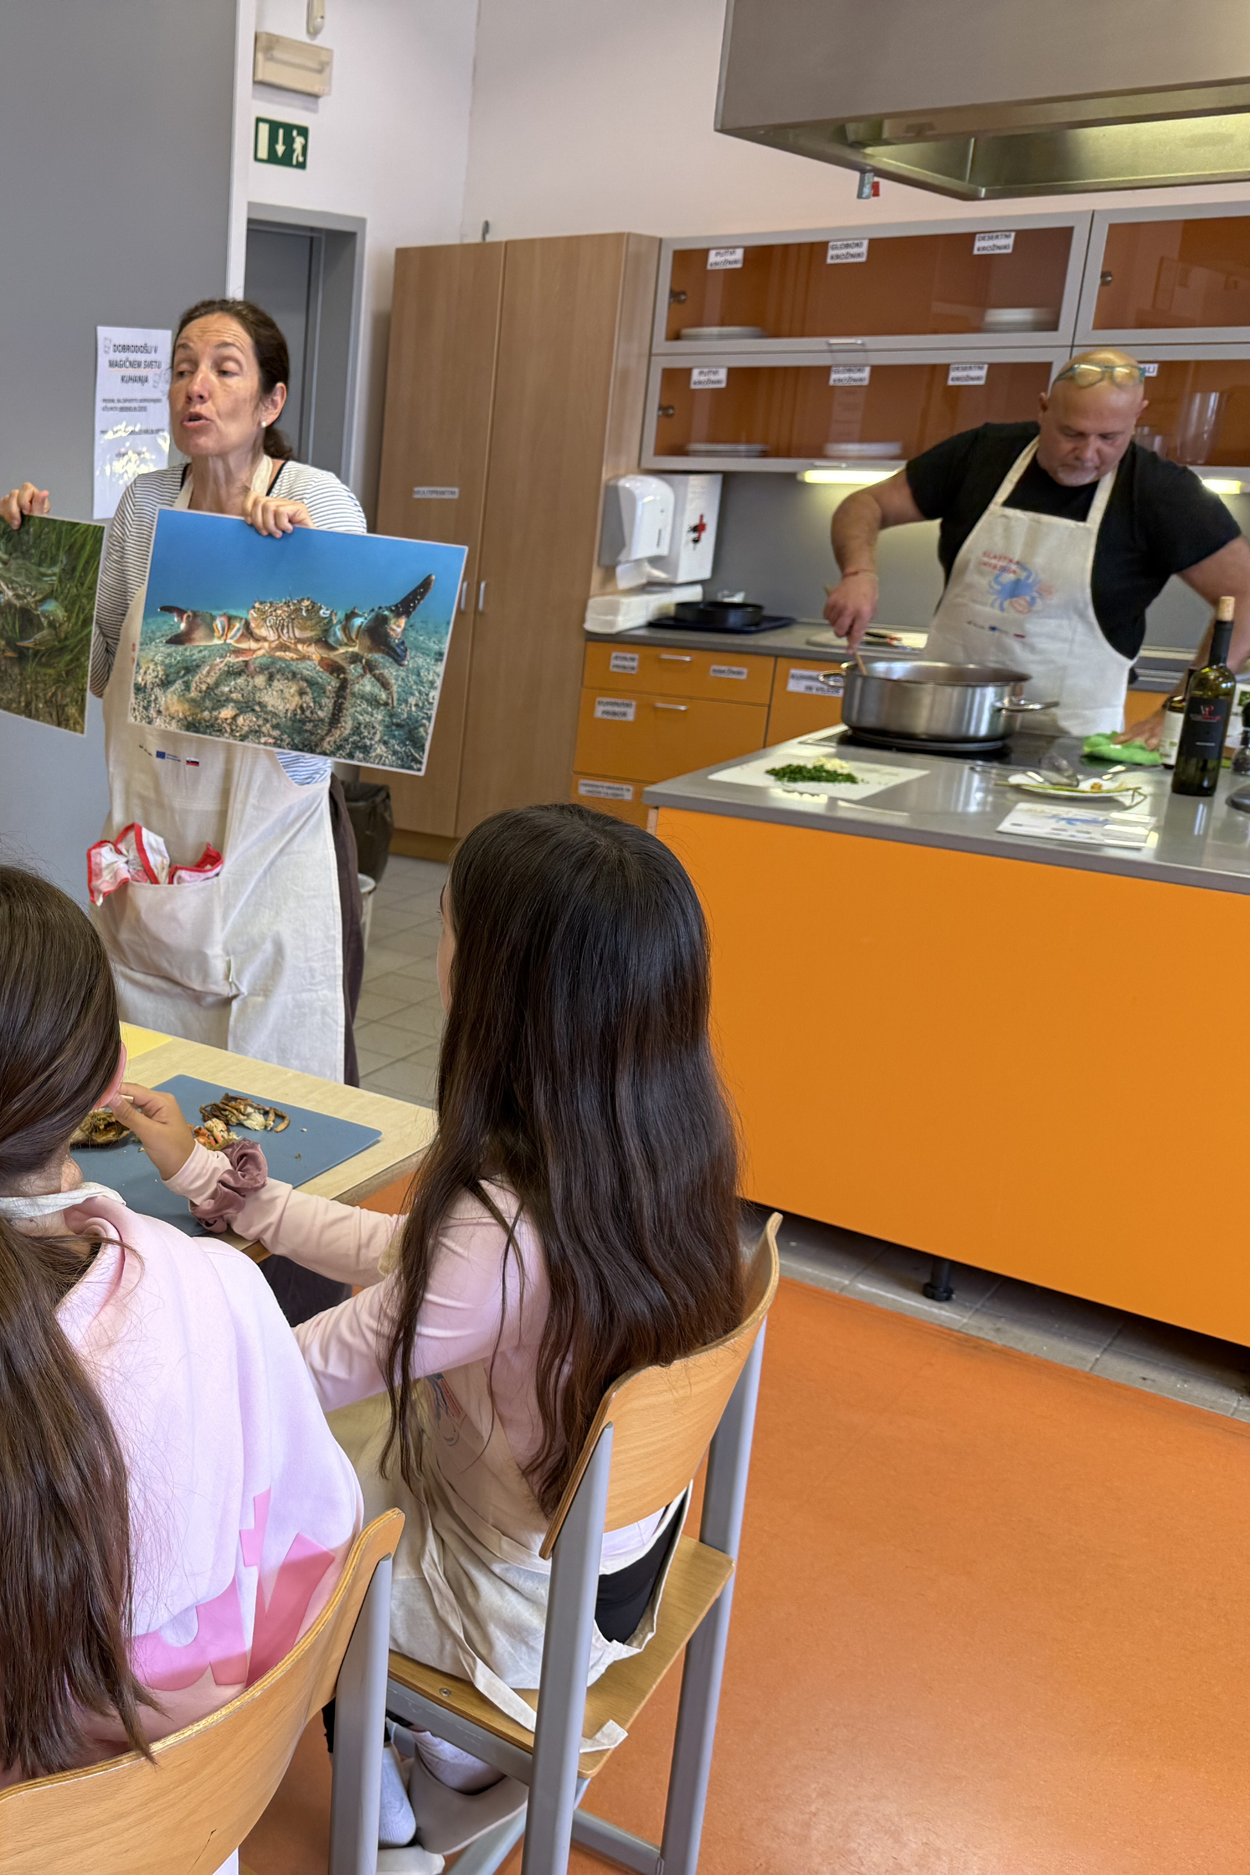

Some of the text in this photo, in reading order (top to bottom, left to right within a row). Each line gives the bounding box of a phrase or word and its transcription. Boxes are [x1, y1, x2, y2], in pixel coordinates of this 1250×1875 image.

[112, 343, 152, 354] DOBRODOŠLI
[108, 358, 162, 369] MAGIČNEM SVETU
[120, 375, 149, 387] KUHANJA
